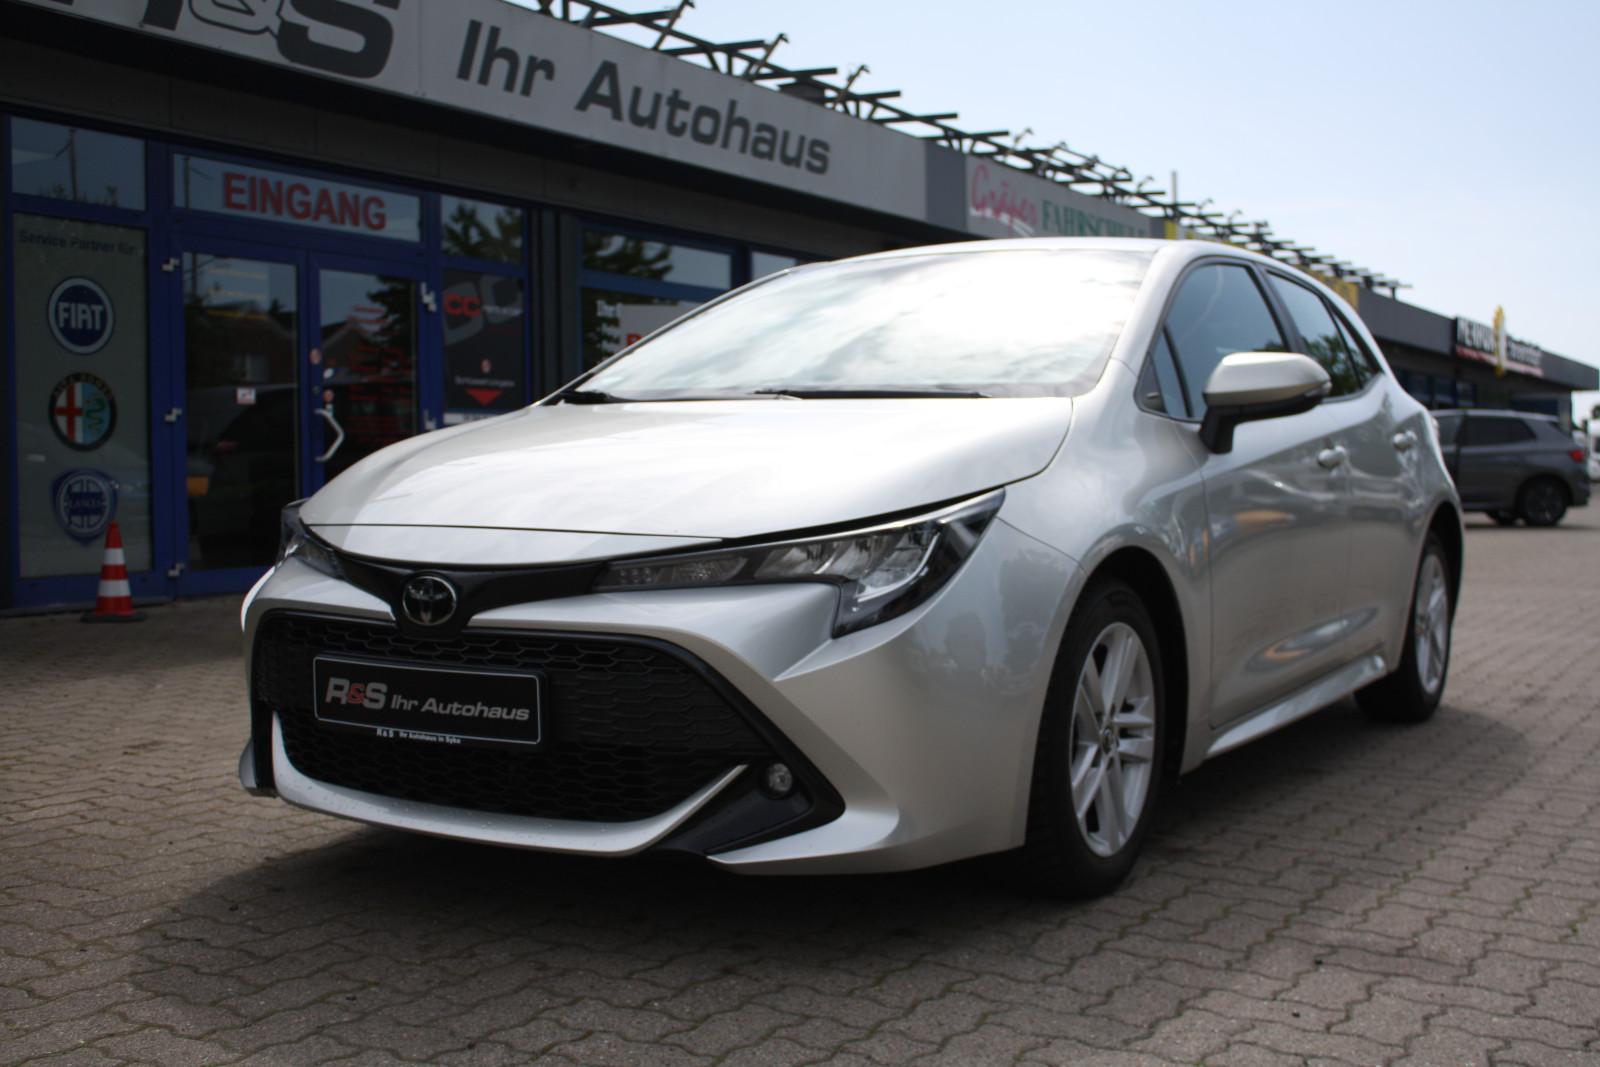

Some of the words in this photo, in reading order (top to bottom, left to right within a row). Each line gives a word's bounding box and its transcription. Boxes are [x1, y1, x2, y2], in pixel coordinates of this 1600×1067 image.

[456, 19, 555, 97] Ihr
[575, 60, 831, 175] Autohaus
[223, 171, 388, 231] EINGANG
[57, 301, 104, 331] FIAT
[324, 677, 388, 710] R&S
[390, 694, 419, 712] Ihr
[421, 697, 530, 722] Autohaus
